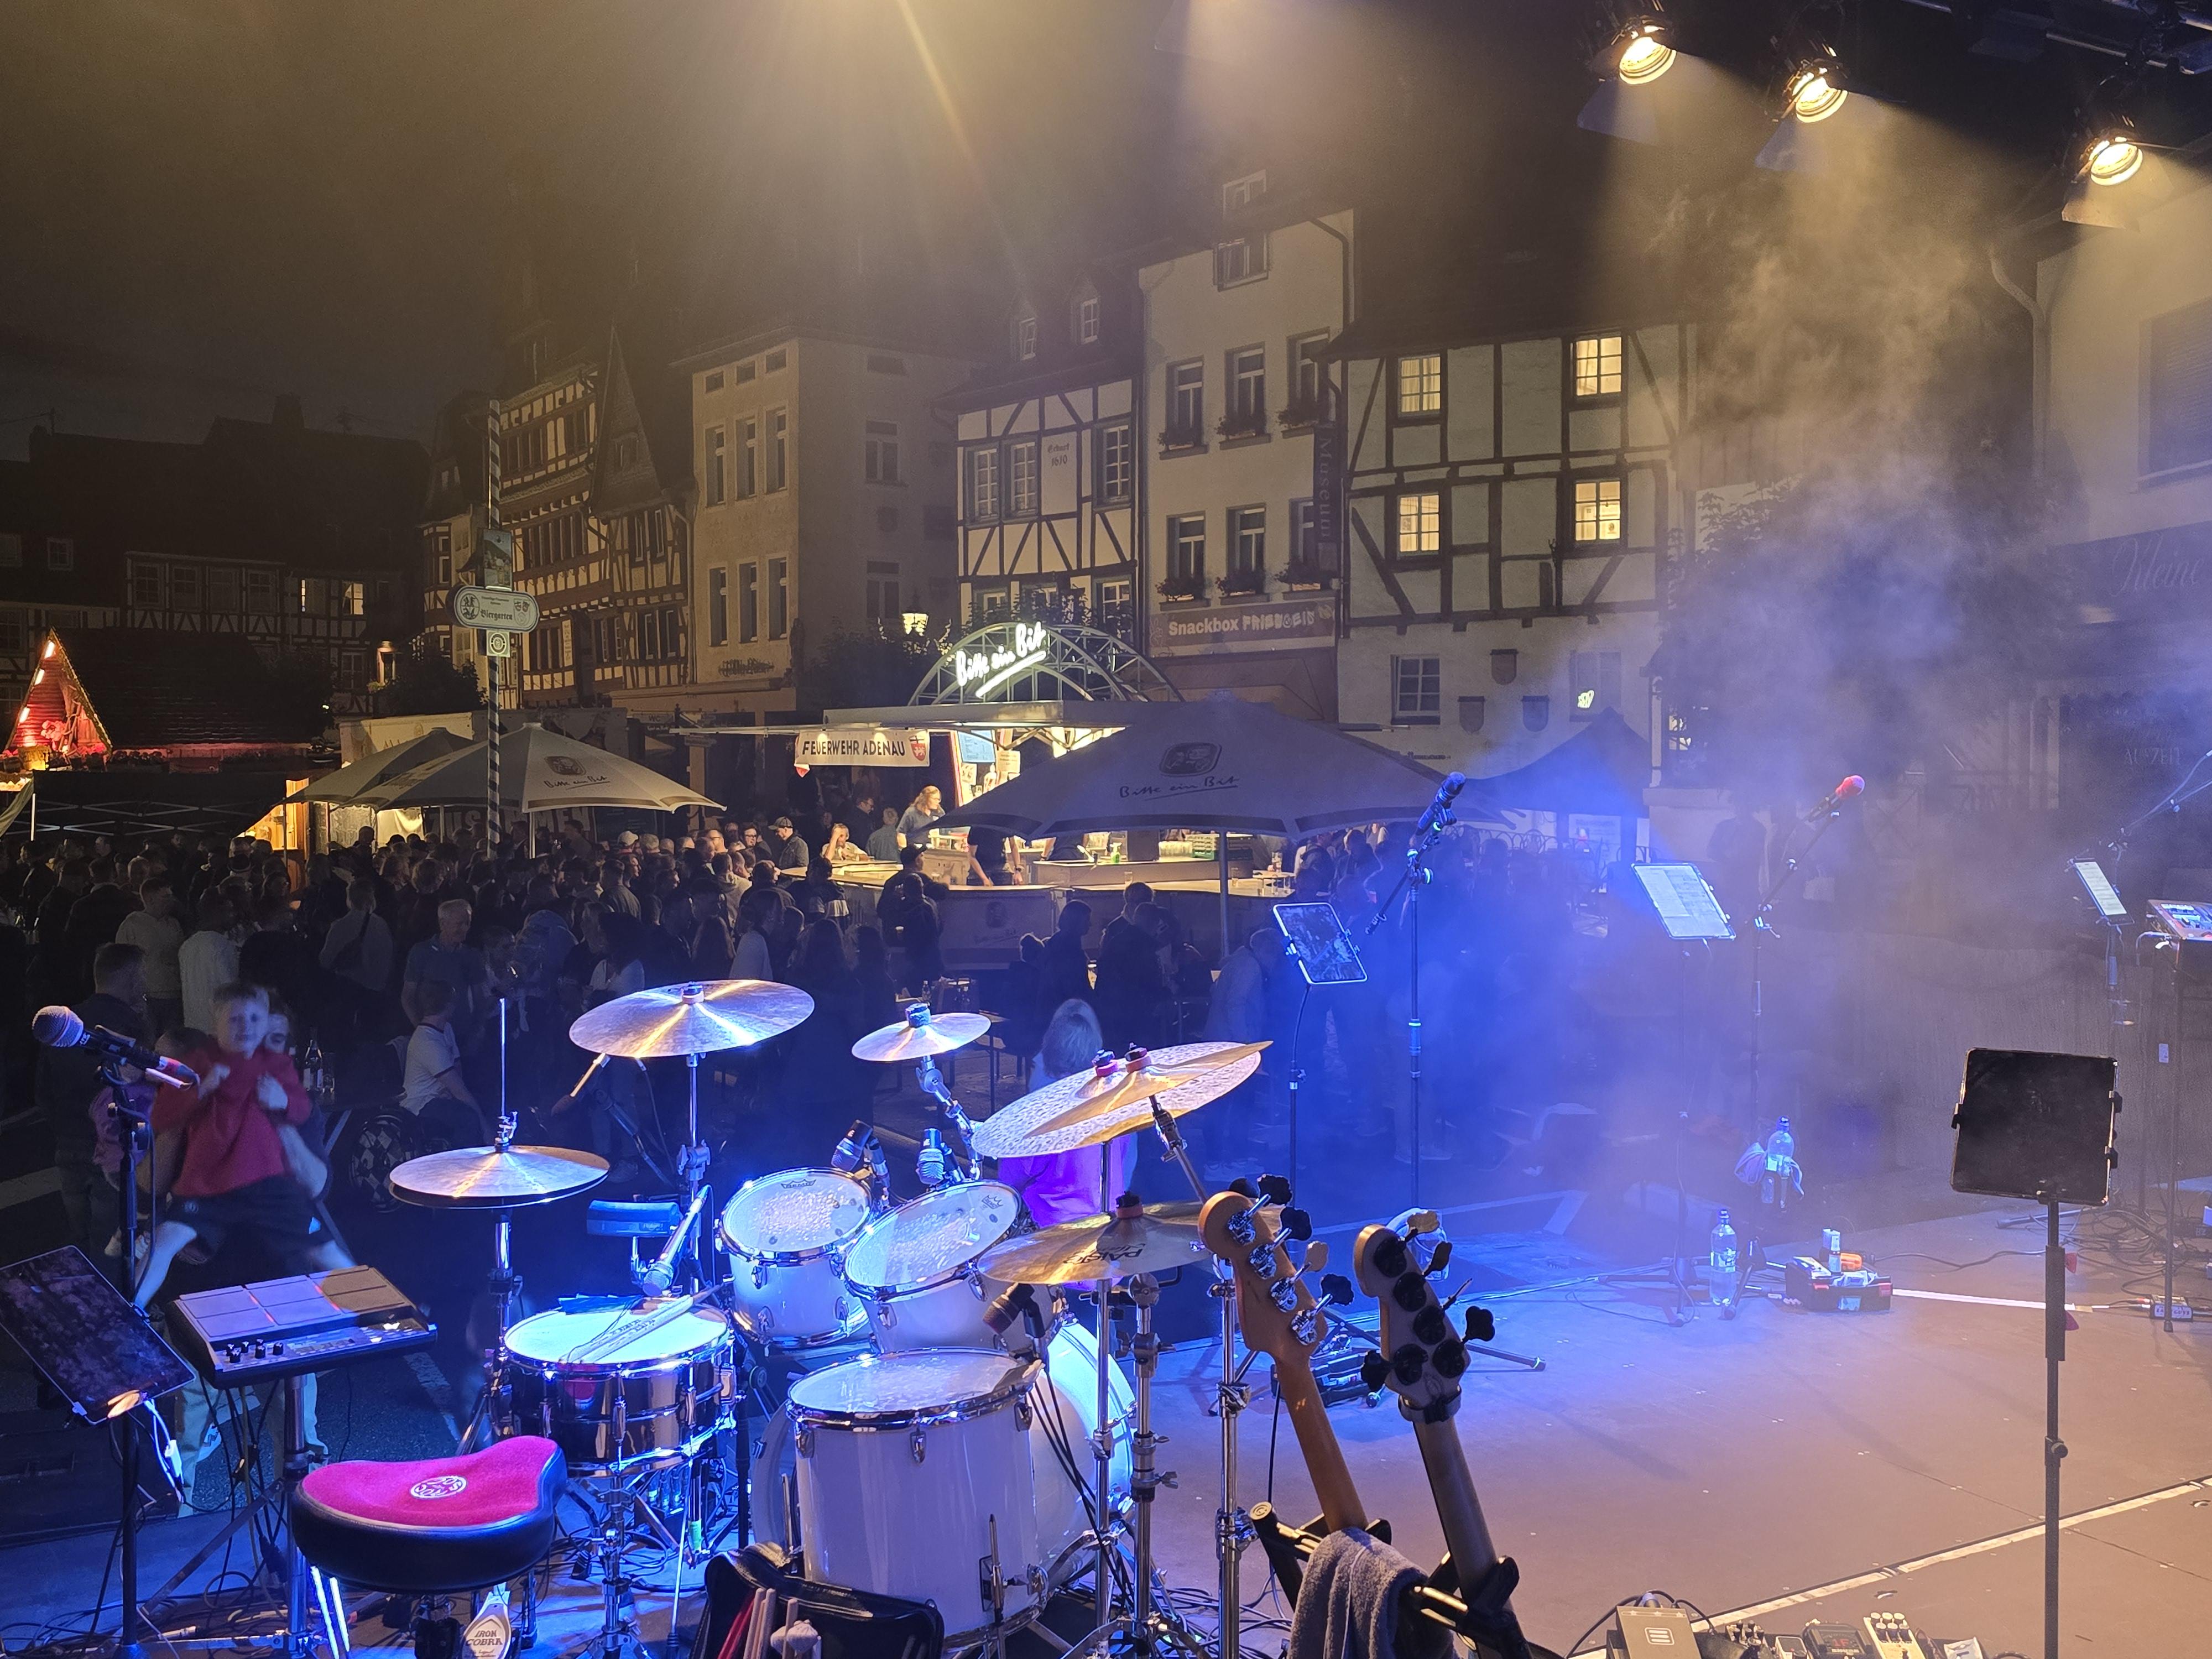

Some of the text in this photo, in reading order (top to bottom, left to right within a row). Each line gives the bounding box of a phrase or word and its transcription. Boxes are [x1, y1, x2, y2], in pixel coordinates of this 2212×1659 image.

[1319, 437, 1332, 538] Museum
[480, 609, 513, 622] Biergarten
[1168, 616, 1240, 636] Snackbox
[802, 739, 905, 757] FEUERWEHR ADENAU
[1119, 775, 1240, 798] Bitte ein Bit
[465, 1638, 503, 1646] COBRA
[474, 1630, 497, 1638] IRON
